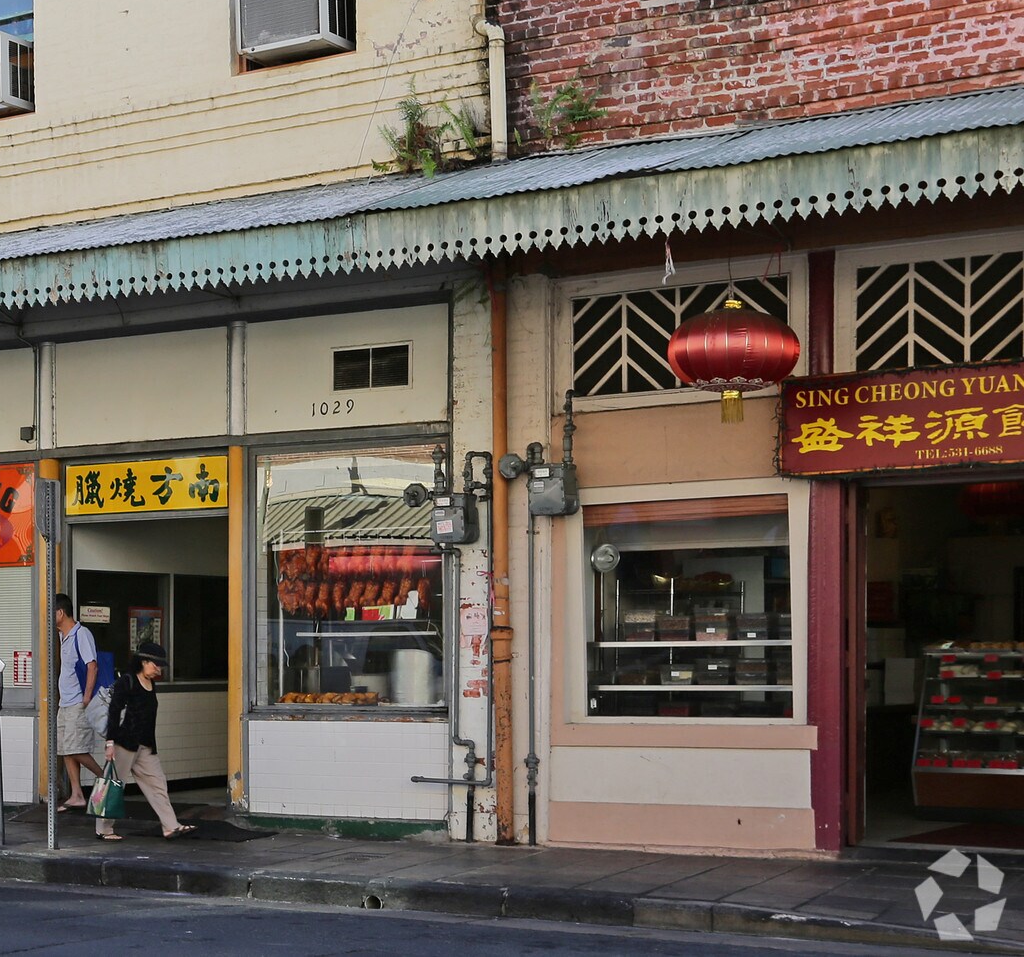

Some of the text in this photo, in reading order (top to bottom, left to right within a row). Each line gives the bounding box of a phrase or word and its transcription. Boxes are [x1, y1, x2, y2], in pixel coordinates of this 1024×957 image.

[795, 388, 849, 409] SING
[854, 379, 955, 404] CHEONG
[311, 398, 355, 417] 1029
[915, 445, 1003, 460] TEL:531-6688
